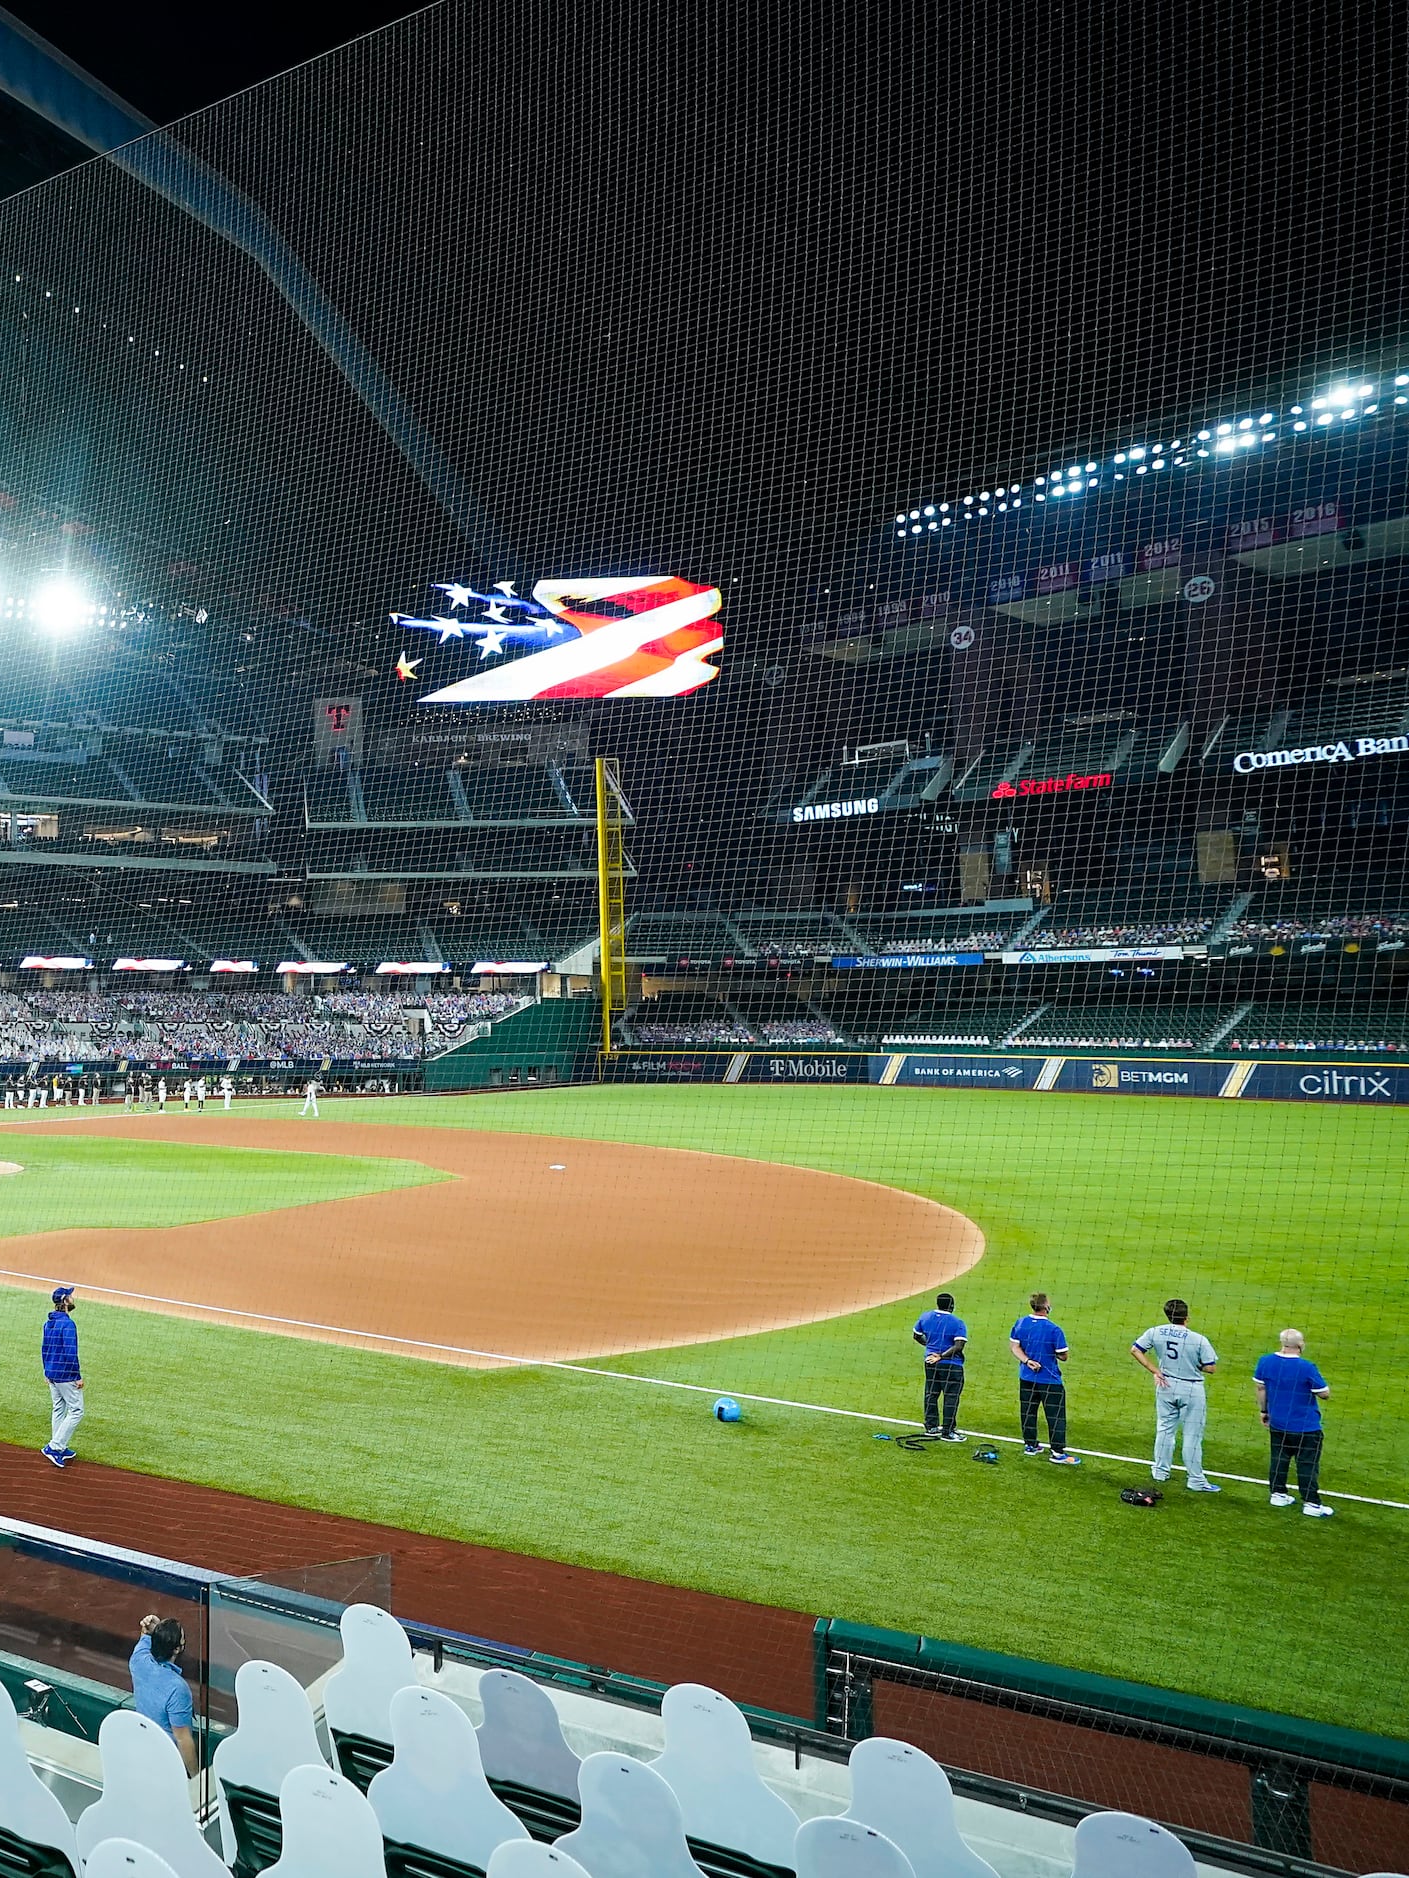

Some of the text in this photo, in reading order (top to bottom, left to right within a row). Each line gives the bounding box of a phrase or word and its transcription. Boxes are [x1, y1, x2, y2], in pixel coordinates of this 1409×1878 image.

[476, 733, 531, 742] BREWING
[1355, 732, 1409, 757] Ban
[792, 798, 879, 823] SAMSUNG
[1038, 953, 1092, 964] Albertsons
[269, 1060, 294, 1069] @MLB
[642, 1061, 666, 1071] FILM
[914, 1066, 1001, 1078] BANK OF AMERICA
[1120, 1070, 1189, 1084] BETMGM
[1299, 1069, 1392, 1098] citrix
[1166, 1341, 1179, 1360] 5
